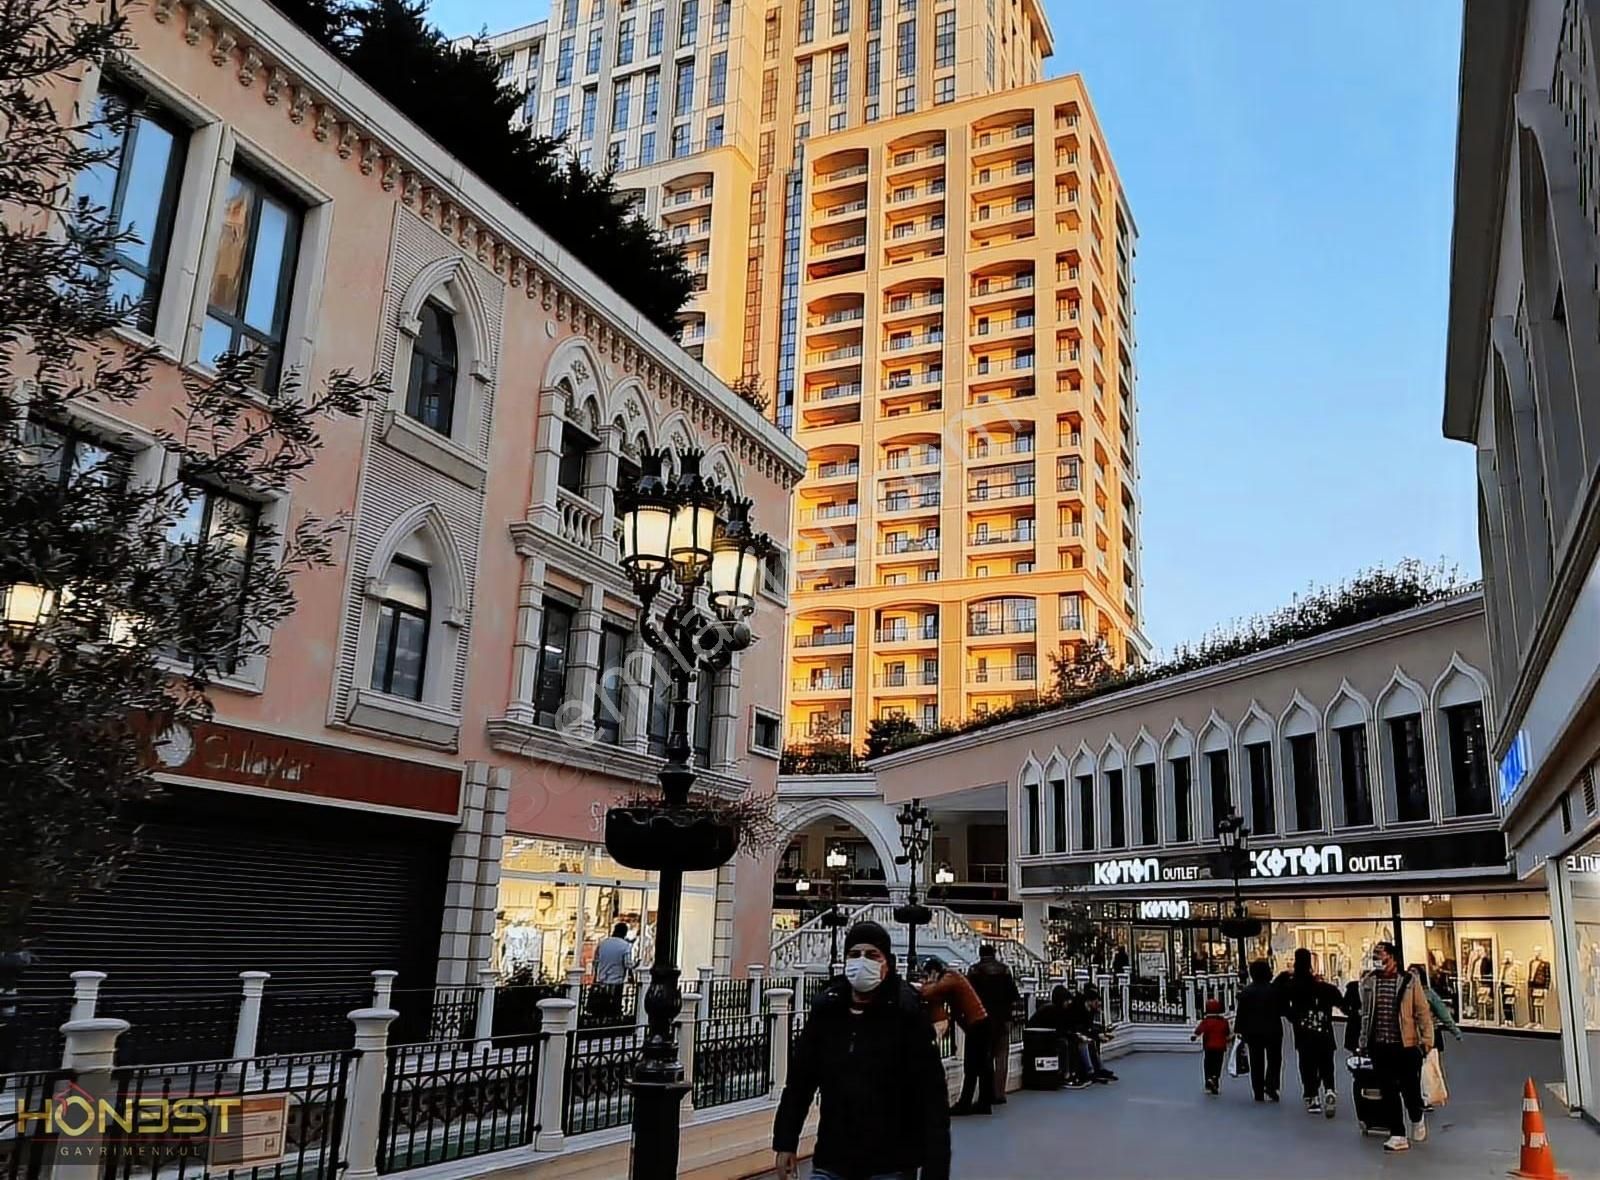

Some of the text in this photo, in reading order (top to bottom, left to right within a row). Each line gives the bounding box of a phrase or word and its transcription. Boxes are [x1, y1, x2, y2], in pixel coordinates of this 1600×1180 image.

[1094, 857, 1200, 886] KOTON OUTLET
[1250, 844, 1403, 878] KOTON OUTLET
